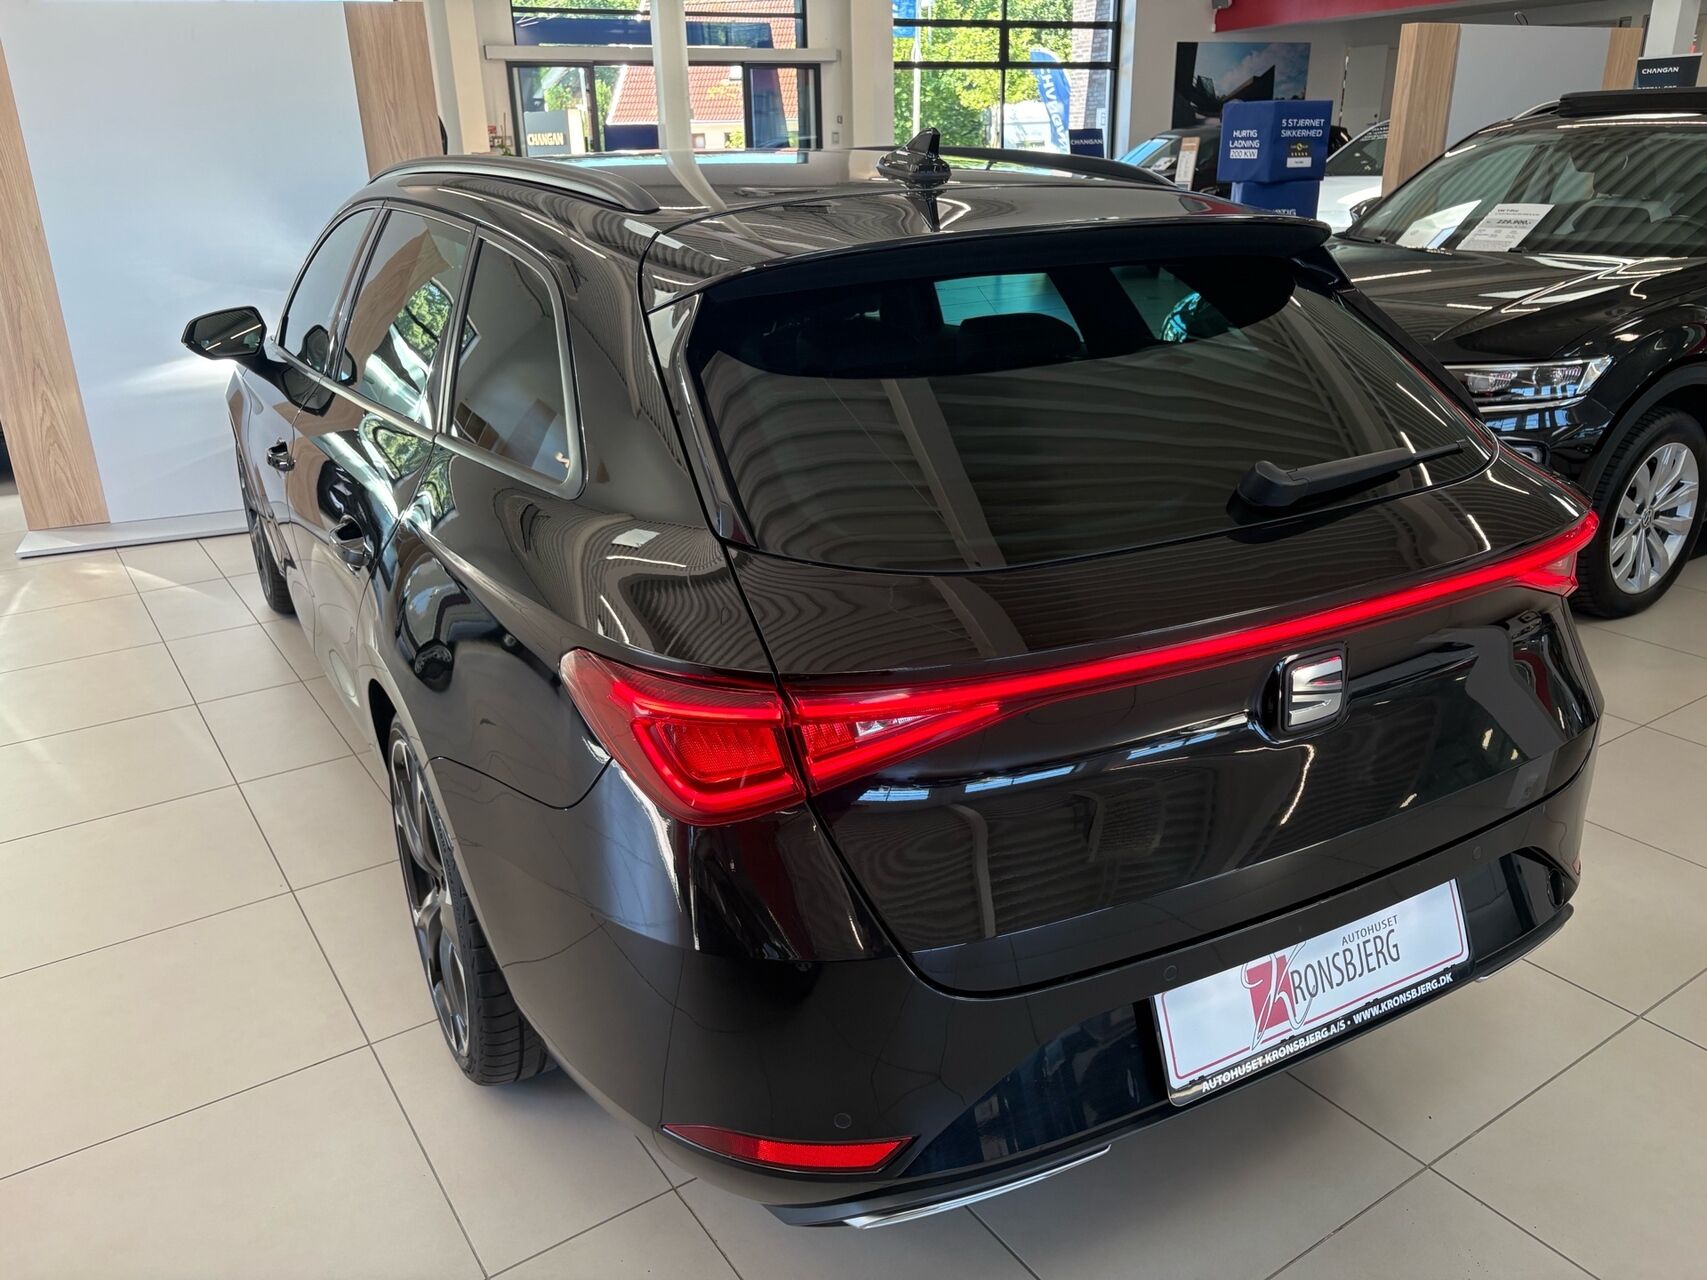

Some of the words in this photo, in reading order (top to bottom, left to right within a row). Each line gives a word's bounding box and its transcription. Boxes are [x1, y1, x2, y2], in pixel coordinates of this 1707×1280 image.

[1642, 66, 1679, 75] CHANGAN
[1281, 119, 1287, 127] 5
[1288, 118, 1325, 127] STJERNET
[1232, 129, 1258, 138] HURTIG
[1280, 129, 1323, 138] SIKKERHED
[527, 133, 564, 146] CHANGAN
[1229, 139, 1260, 148] LADNING
[1245, 150, 1257, 158] KW
[1341, 914, 1399, 947] AUTOHUSET
[1329, 1019, 1346, 1036] A/S
[1352, 972, 1454, 1025] WWW.KRONSBJERG.DK
